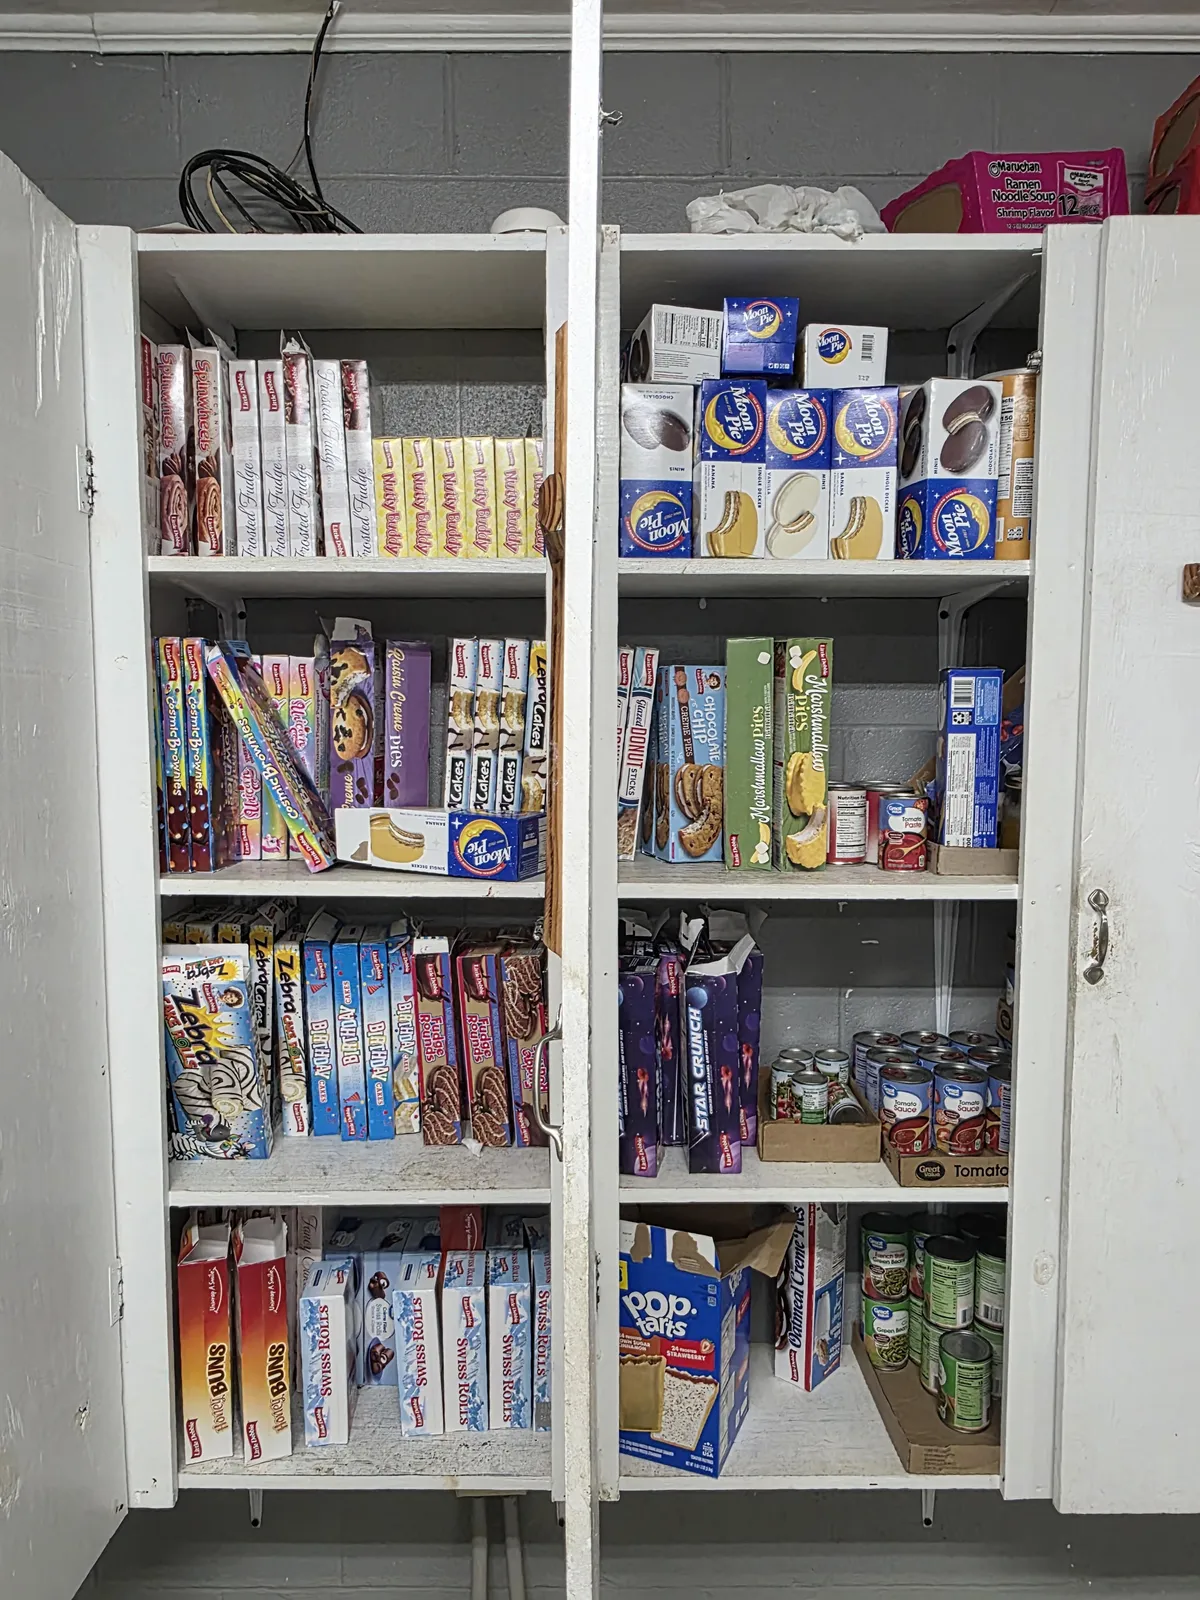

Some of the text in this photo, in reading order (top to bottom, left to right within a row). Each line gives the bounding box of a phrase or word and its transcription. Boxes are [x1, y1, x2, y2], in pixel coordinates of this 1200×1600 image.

[997, 160, 1040, 172] Maruchan
[1005, 178, 1041, 189] Ramen
[992, 190, 1056, 204] Noodle Soup
[997, 207, 1054, 219] Shrimp Flavor
[1059, 195, 1078, 215] 12
[742, 306, 769, 324] Moon
[759, 312, 774, 327] Pie
[817, 333, 840, 347] Moon
[830, 340, 844, 353] Pie
[159, 351, 178, 449] Spinwheels
[194, 359, 211, 452] Spinwheels
[238, 373, 250, 411] Little Debbie
[266, 373, 279, 411] Little Debbie
[731, 386, 754, 432] Moon
[317, 368, 343, 473] Frosted Fudge
[724, 416, 742, 440] Pie
[787, 421, 805, 445] Pie
[794, 392, 817, 436] Moon
[855, 422, 872, 446] Pie
[862, 393, 885, 436] Moon
[238, 462, 260, 510] Fudge
[382, 472, 398, 512] Nutty
[412, 471, 429, 512] Nutty
[443, 471, 460, 512] Nutty
[473, 468, 490, 507] Nutty
[385, 512, 402, 557] Buddy
[415, 511, 433, 556] Buddy
[445, 511, 463, 557] Buddy
[474, 506, 494, 552] Buddy
[639, 510, 663, 529] Pie
[648, 517, 690, 542] Moon
[904, 509, 913, 532] Pie
[941, 513, 964, 557] Moon
[953, 503, 971, 529] Pie
[165, 644, 176, 681] Little Debbie
[187, 644, 199, 681] Little Debbie
[388, 647, 406, 768] Raisin Creme pies
[634, 699, 647, 728] Glazed
[691, 709, 708, 744] CHIP
[795, 694, 810, 732] pies
[804, 674, 829, 772] Marshmallow
[165, 696, 182, 796] Cosmic Brownies
[187, 696, 204, 796] Cosmic Brownies
[626, 726, 647, 769] DONUT
[680, 705, 693, 758] CREME PIES
[703, 695, 721, 762] CHOCOLATE
[238, 718, 280, 781] Brownies
[749, 705, 771, 824] Marshmallow pies
[269, 775, 299, 820] Cosmic
[450, 760, 464, 802] Cakes
[476, 759, 491, 802] Cakes
[502, 760, 516, 802] Cakes
[627, 768, 638, 796] STICKS
[467, 838, 487, 854] Pie
[474, 846, 511, 867] Moon
[430, 864, 446, 872] SINGLE
[187, 963, 228, 980] Zebra
[254, 935, 270, 985] Zebra
[276, 954, 296, 1013] Zebra
[342, 980, 352, 1004] CAKES
[171, 987, 218, 1065] Zebra
[282, 1014, 297, 1041] CAKE
[338, 1004, 360, 1066] BIRTHDAY
[397, 1000, 416, 1055] BIRTHDAY
[419, 1013, 436, 1063] Rounds
[430, 1015, 446, 1058] Fudge
[466, 1014, 483, 1064] Rounds
[478, 1016, 493, 1059] Fudge
[310, 1019, 332, 1080] BIRTHDAY
[367, 1021, 389, 1082] BIRTHDAY
[402, 1053, 410, 1073] CAKES
[688, 1006, 709, 1131] STAR CRUNCH
[318, 1080, 328, 1104] CAKES
[375, 1082, 385, 1106] CAKES
[893, 1105, 917, 1113] Sauce
[722, 1134, 730, 1153] Debbie
[919, 1165, 940, 1173] Great
[954, 1164, 1009, 1178] Tomato
[301, 1214, 318, 1251] Fancy
[791, 1240, 806, 1287] Creme
[536, 1290, 550, 1377] SWISS ROLLS
[636, 1316, 688, 1339] tarts
[788, 1286, 805, 1349] Oatmeal
[318, 1304, 333, 1397] SWISS ROLLS
[412, 1296, 428, 1387] SWISS ROLLS
[666, 1350, 706, 1361] STRAWBERRY
[209, 1343, 229, 1434] Honey BUNS
[268, 1343, 289, 1434] Honey BUNS
[456, 1337, 470, 1426] SWISS ROLLS
[502, 1334, 514, 1423] SWISS ROLLS
[188, 1421, 201, 1457] Little Debbie
[248, 1423, 257, 1443] Debbie
[702, 1451, 713, 1459] USA
